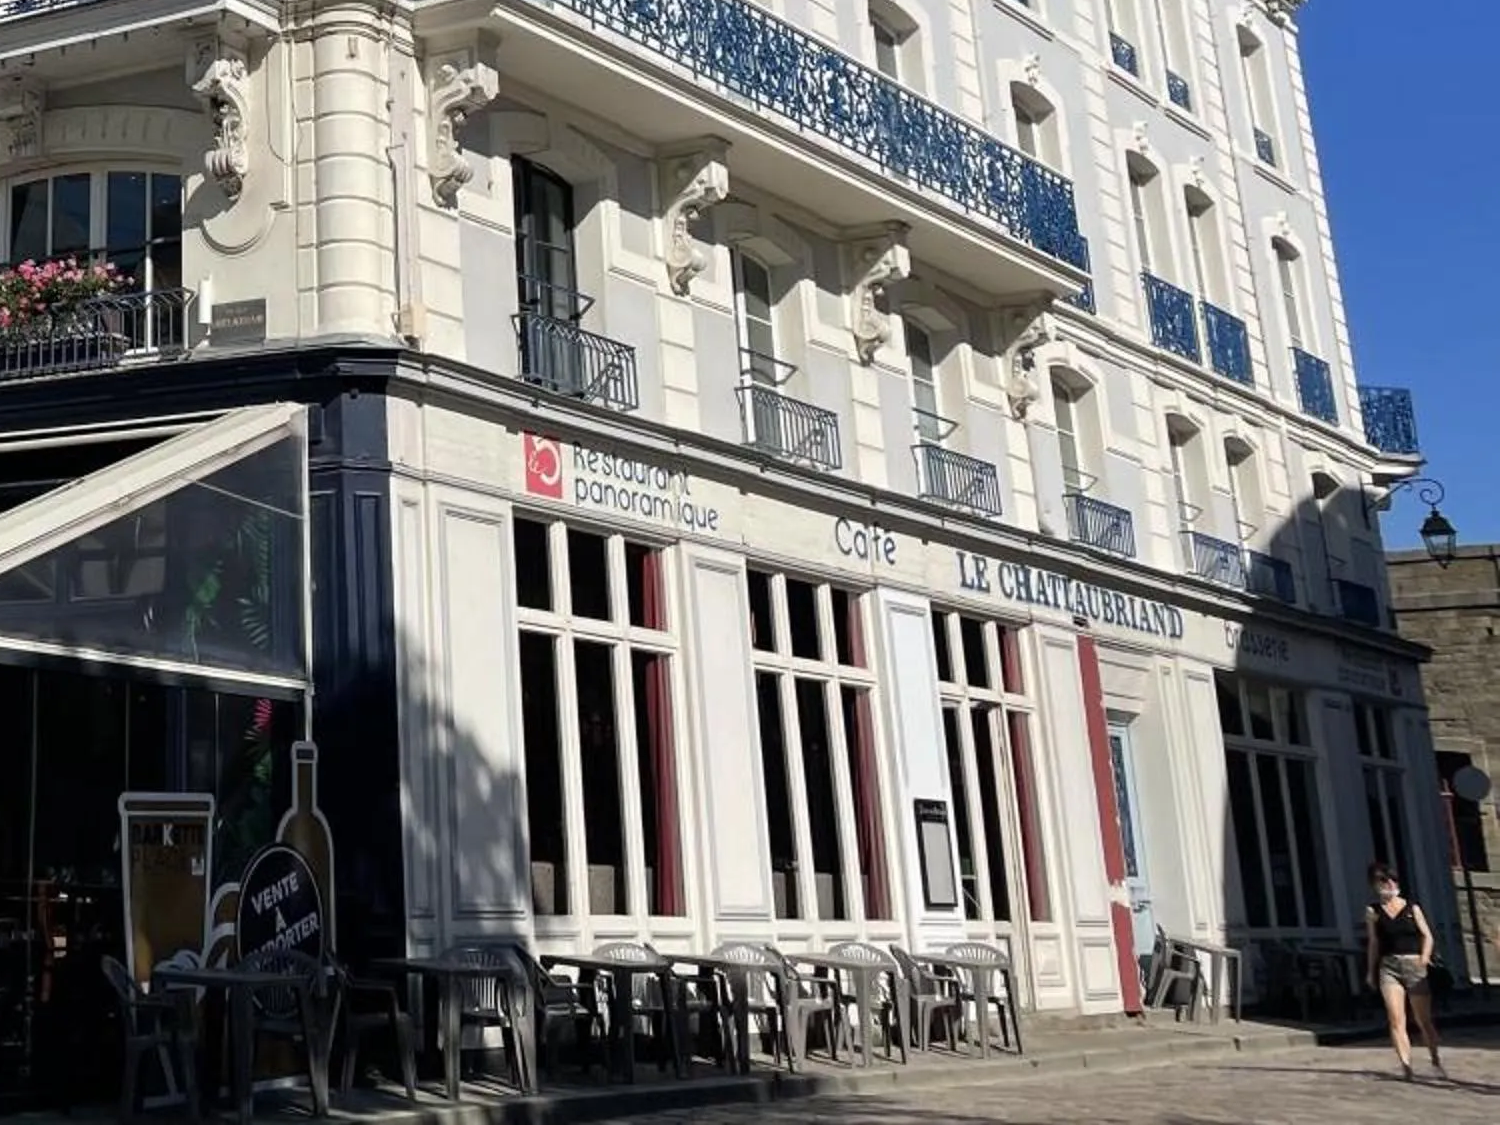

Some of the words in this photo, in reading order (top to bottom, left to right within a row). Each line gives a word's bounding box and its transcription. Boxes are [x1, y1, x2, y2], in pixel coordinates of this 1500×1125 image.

[572, 441, 691, 496] Restaurant
[575, 477, 719, 532] panoramique
[956, 551, 991, 593] LE
[251, 872, 299, 915] VENTE
